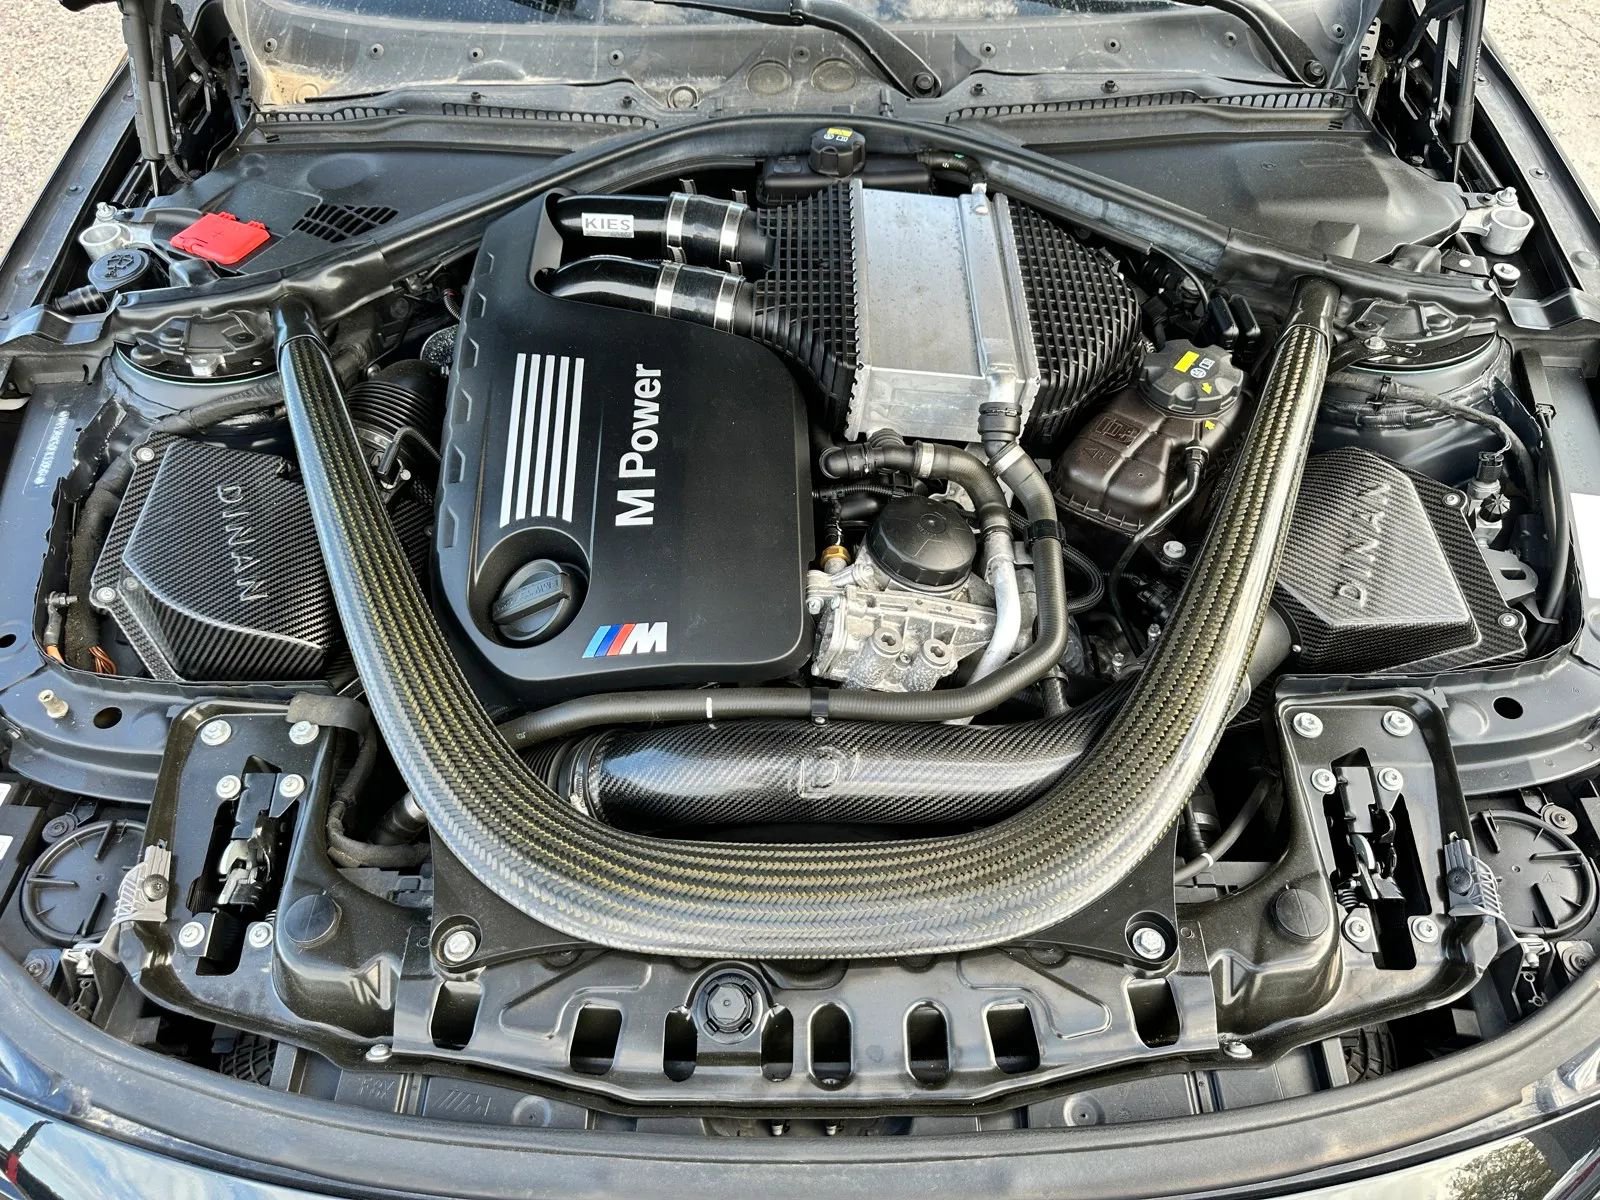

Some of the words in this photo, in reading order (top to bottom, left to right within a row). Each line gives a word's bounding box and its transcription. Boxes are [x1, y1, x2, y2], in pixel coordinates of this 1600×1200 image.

[585, 217, 631, 231] KIES
[618, 363, 662, 478] Power
[217, 484, 269, 602] DINAN
[615, 488, 656, 526] M
[1334, 479, 1391, 607] DINAN
